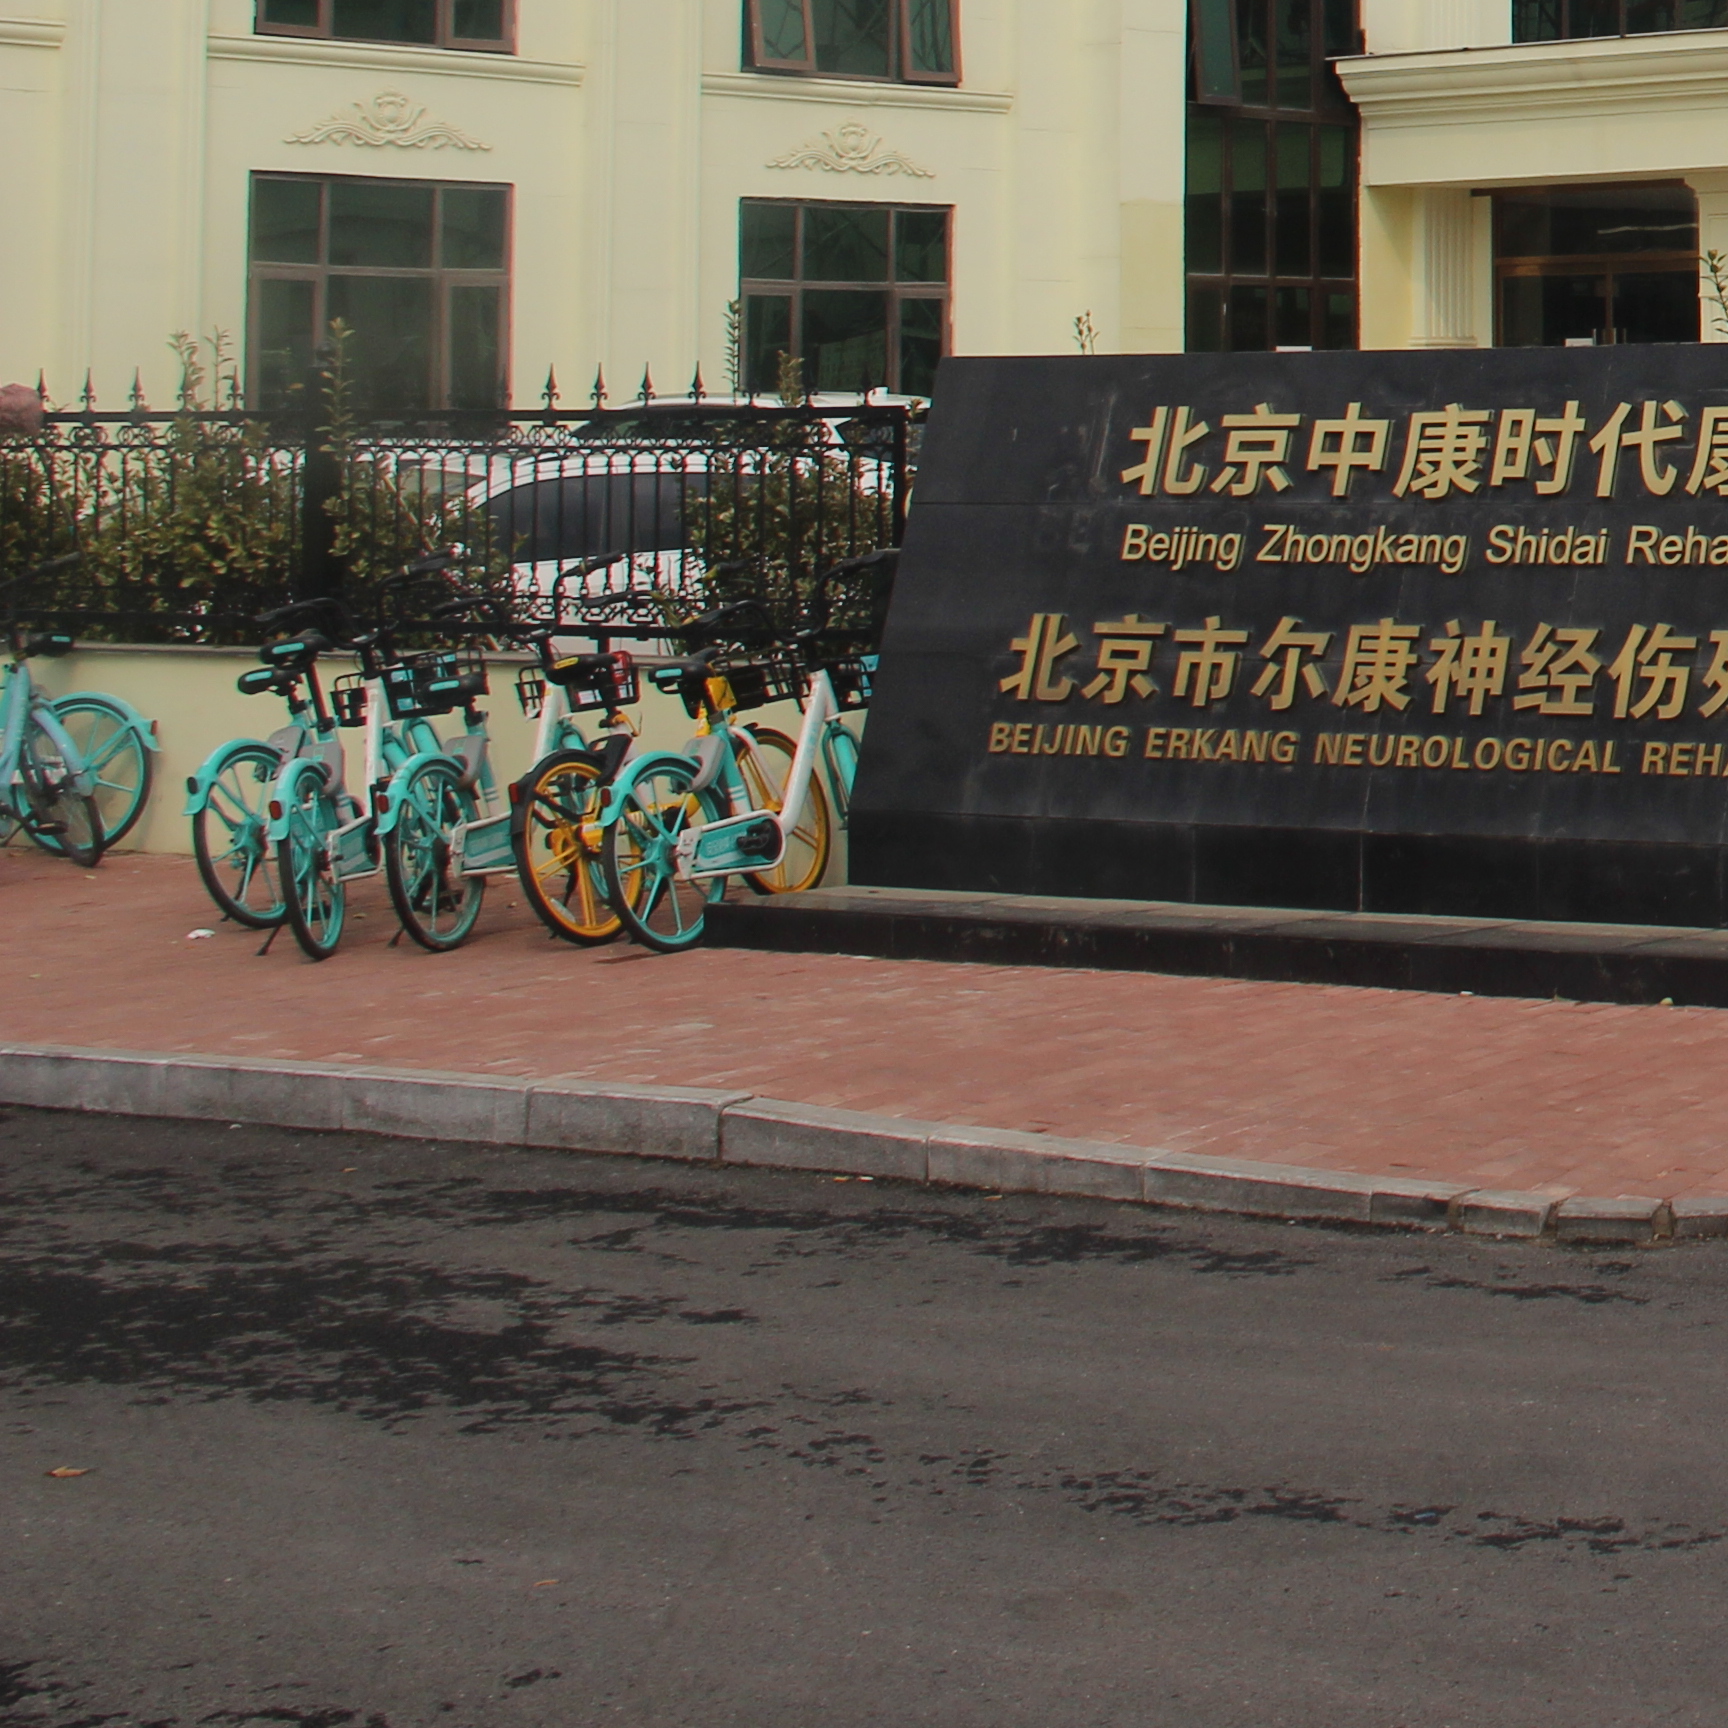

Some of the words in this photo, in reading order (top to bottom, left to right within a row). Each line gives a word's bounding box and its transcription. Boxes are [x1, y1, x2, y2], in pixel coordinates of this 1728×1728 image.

[1121, 522, 1243, 572] Beijing
[1256, 522, 1468, 575] Zhongkang
[1485, 523, 1608, 566] Shidai
[989, 721, 1131, 759] BEIJING
[1143, 726, 1300, 765] ERKANG
[1314, 731, 1623, 774] NEUROLOGICAL
